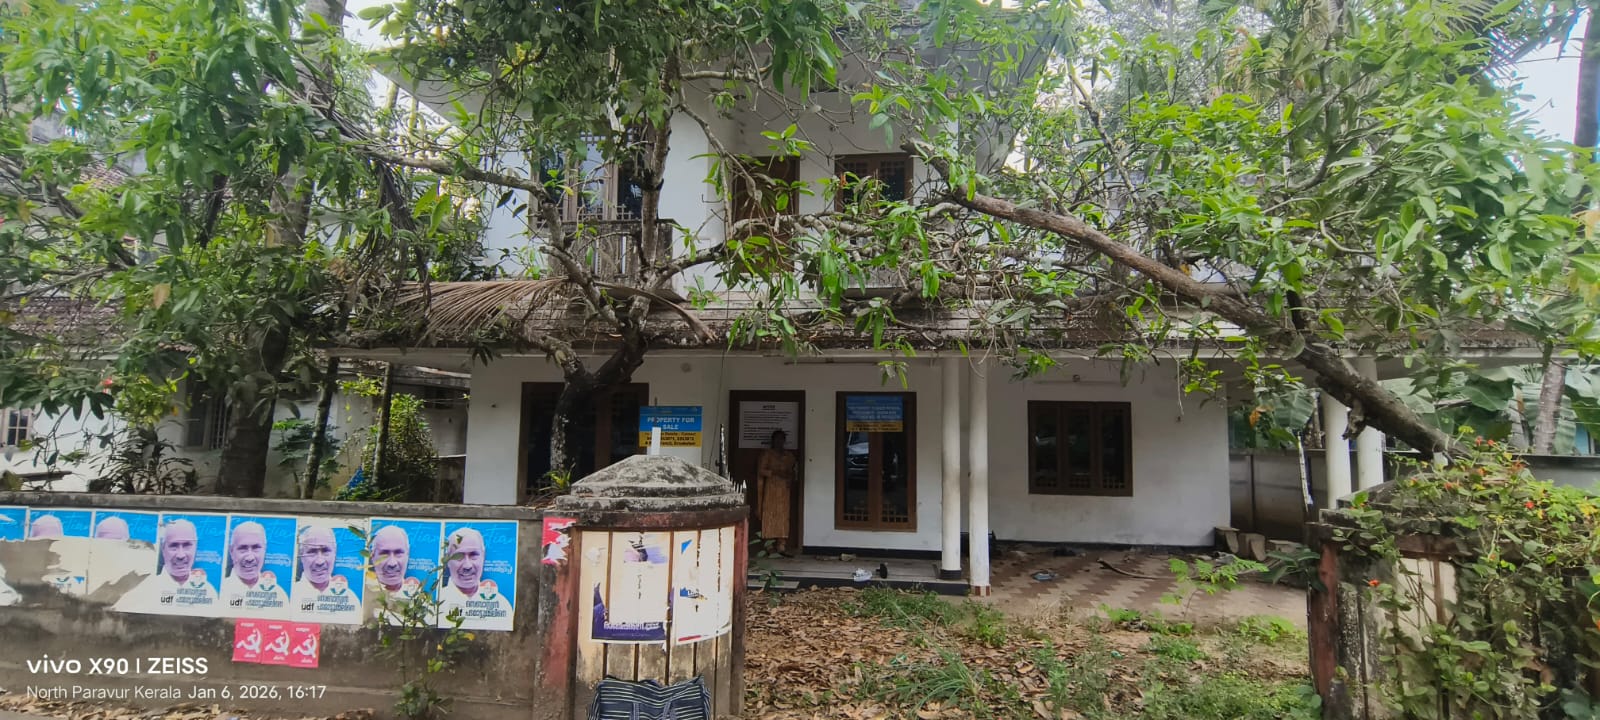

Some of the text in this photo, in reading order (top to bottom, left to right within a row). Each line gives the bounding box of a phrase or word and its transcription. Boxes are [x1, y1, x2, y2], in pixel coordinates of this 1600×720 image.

[160, 595, 174, 603] udf
[229, 598, 243, 606] udf
[300, 603, 314, 612] udf
[449, 608, 463, 617] uf
